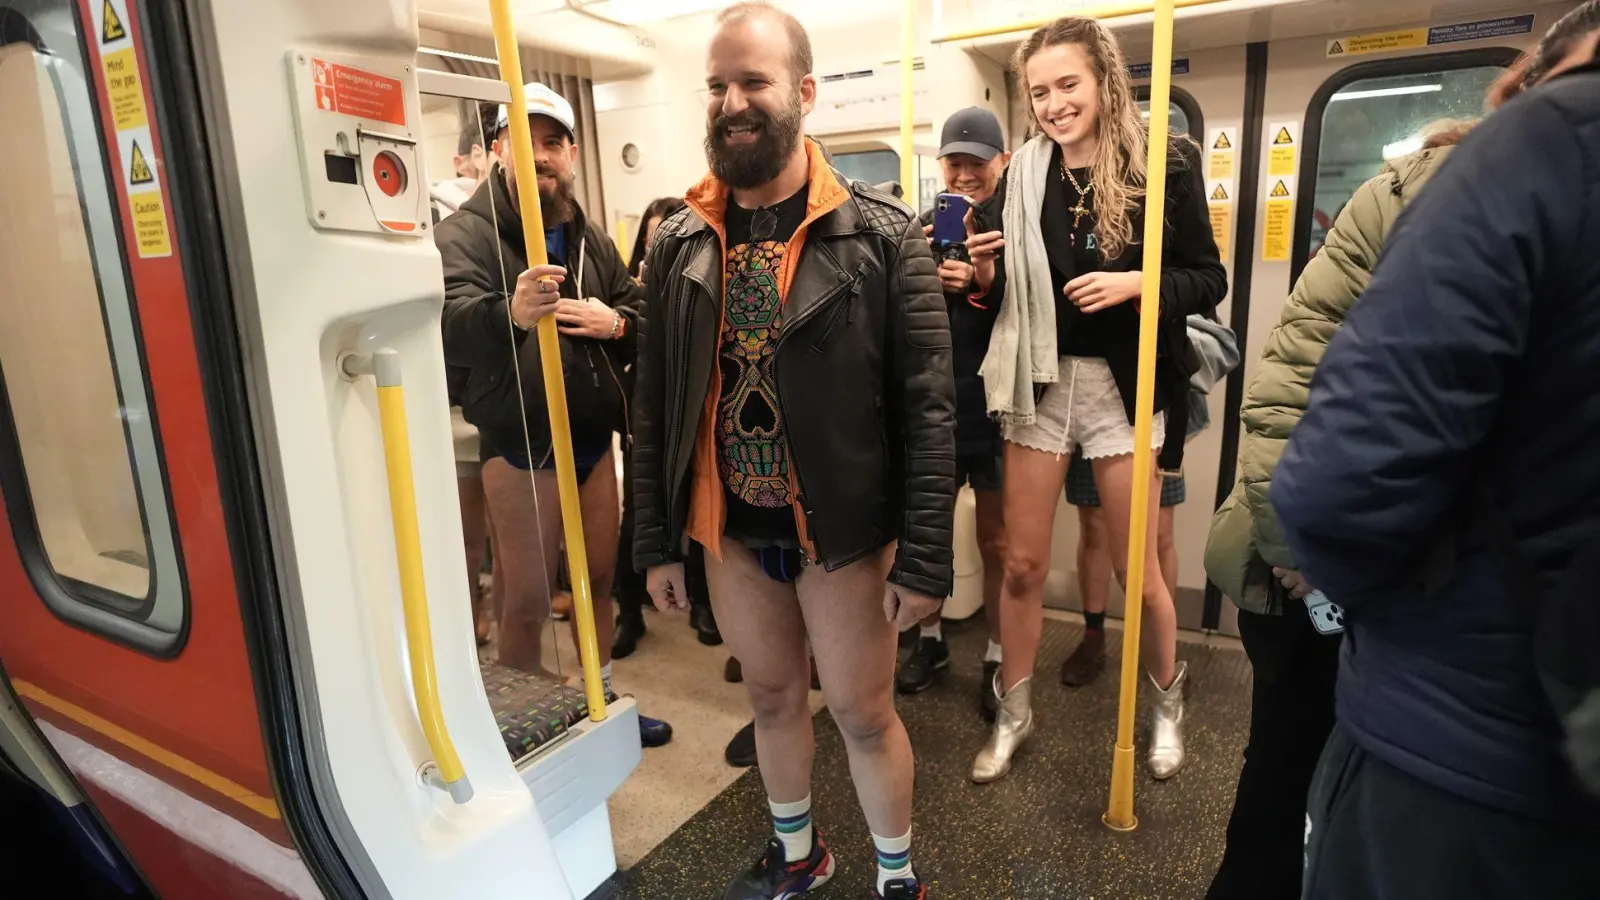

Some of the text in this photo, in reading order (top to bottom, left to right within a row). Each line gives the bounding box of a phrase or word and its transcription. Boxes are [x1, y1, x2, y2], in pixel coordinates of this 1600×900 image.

[107, 57, 124, 73] Mind
[111, 74, 137, 90] the gap
[336, 69, 373, 87] Emergency
[375, 80, 393, 92] alarm
[135, 201, 160, 214] Caution
